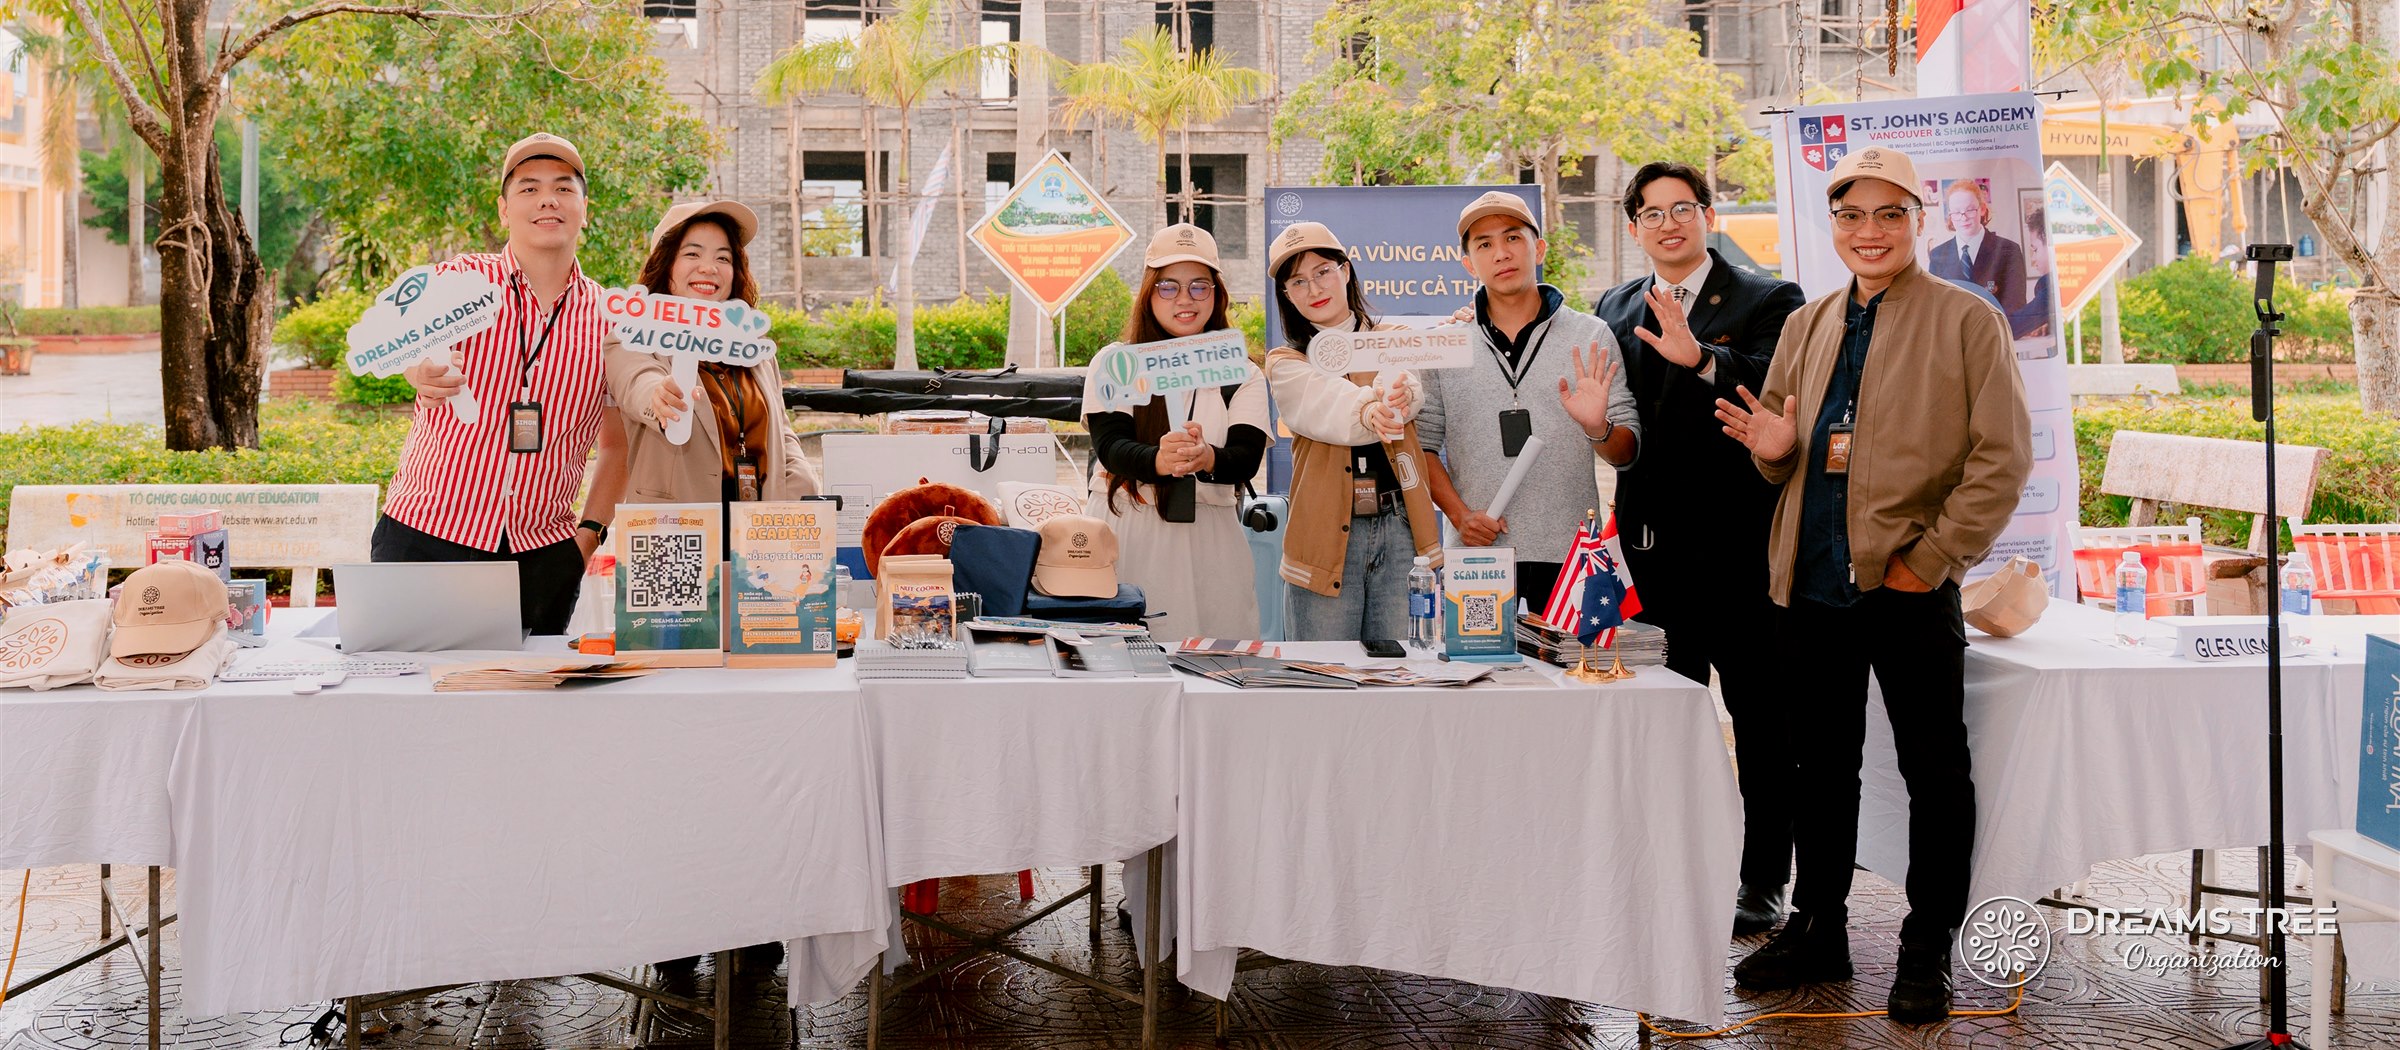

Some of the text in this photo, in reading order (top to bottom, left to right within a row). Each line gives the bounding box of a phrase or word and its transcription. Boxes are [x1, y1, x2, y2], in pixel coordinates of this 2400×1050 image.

[1851, 117, 1877, 131] ST.
[1954, 105, 2035, 124] ACADEMY
[1869, 122, 2030, 140] VANCOUVER & SHAWNIGAN LAKE
[1970, 138, 1992, 146] Diploma
[1343, 241, 1462, 262] A VÙNG AN
[1364, 274, 1483, 300] PHỤC CẢ TH
[607, 290, 722, 328] CÓ IELTS
[354, 292, 495, 368] DREAMS ACADEMY
[378, 314, 488, 370] Language without Borders
[660, 330, 724, 355] CŨNG
[1138, 332, 1240, 354] Dreams Tree Organization
[1354, 335, 1466, 350] DREAMS TREE
[1146, 352, 1190, 371] Phát
[1378, 352, 1443, 366] Organization
[1156, 364, 1246, 390] Bản Thân
[952, 446, 1048, 455] DCP-L50D
[146, 491, 177, 505] CHỨC
[180, 490, 207, 505] GIÁO
[210, 492, 232, 506] DỤC
[235, 492, 255, 504] AVT
[258, 492, 320, 504] EDUCATION
[126, 515, 158, 526] Hotline:
[752, 514, 816, 526] DREAMS
[746, 527, 821, 540] ACADEMY
[1453, 570, 1506, 580] SCAN HERE
[2195, 637, 2241, 658] GLES
